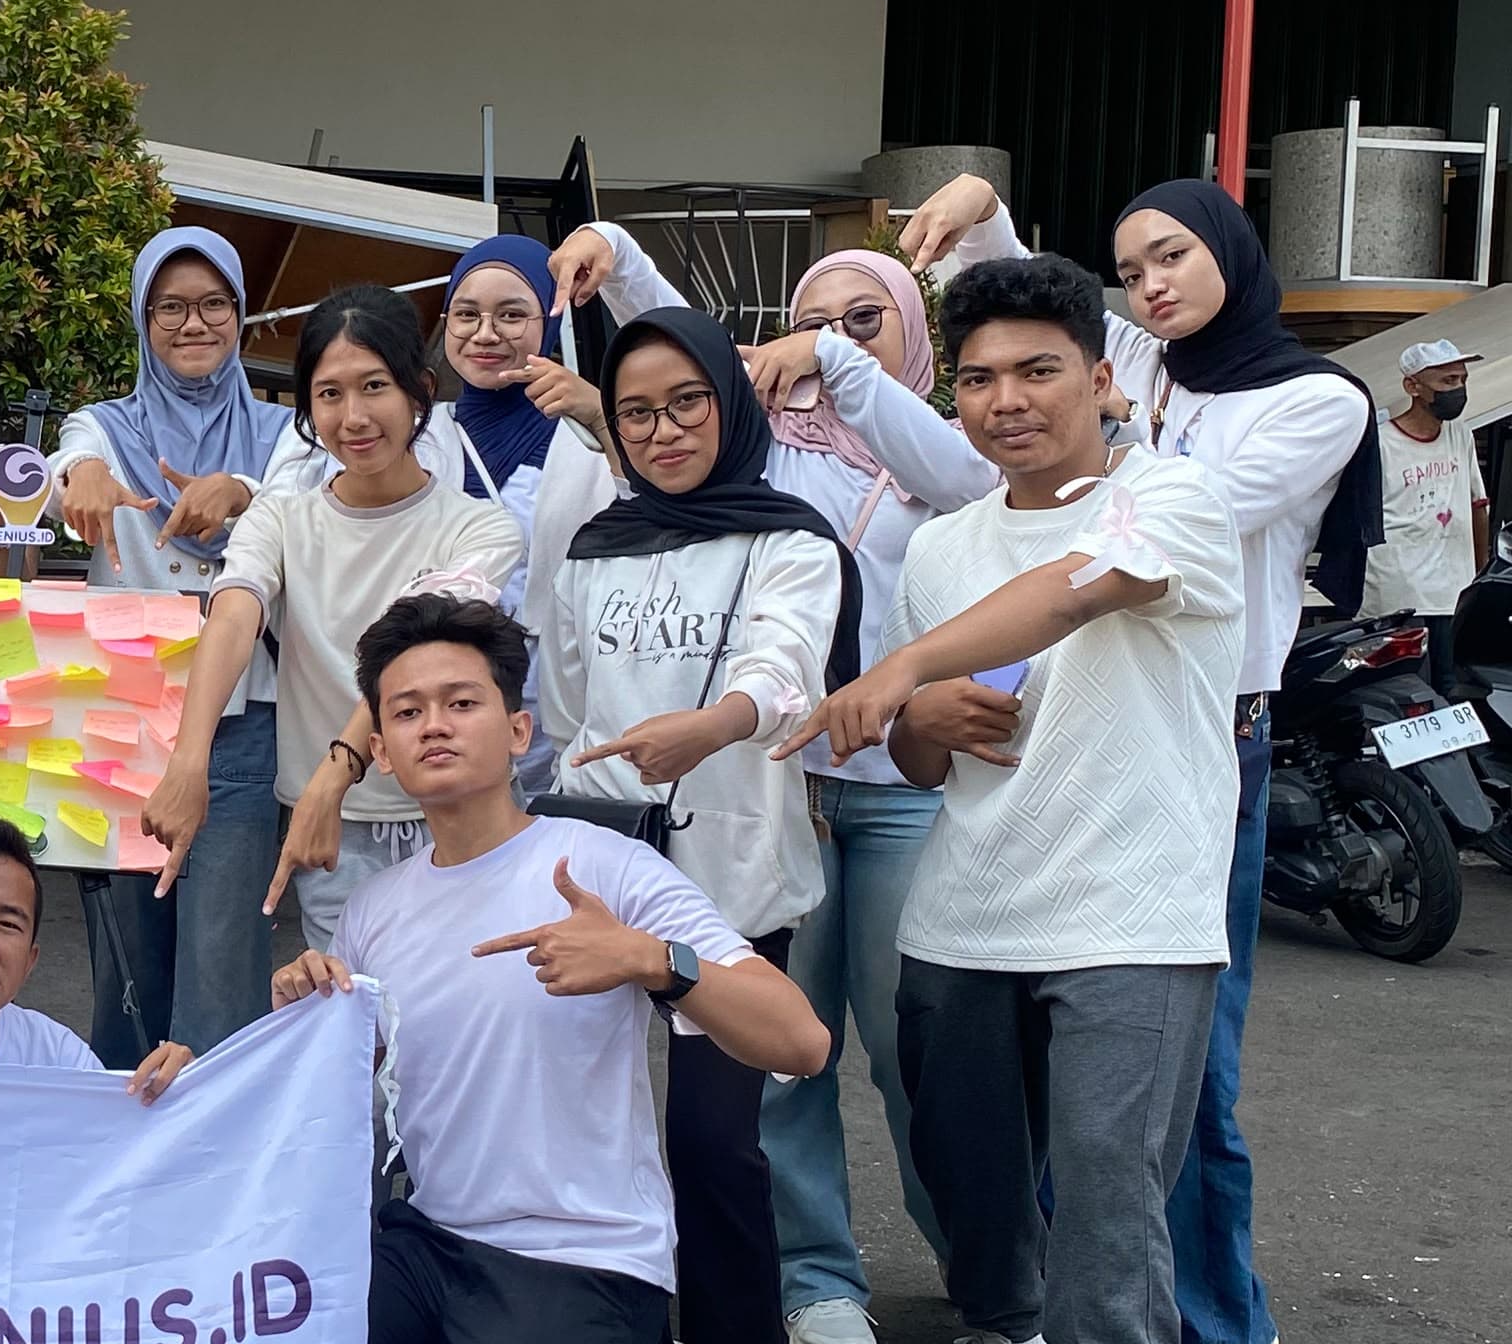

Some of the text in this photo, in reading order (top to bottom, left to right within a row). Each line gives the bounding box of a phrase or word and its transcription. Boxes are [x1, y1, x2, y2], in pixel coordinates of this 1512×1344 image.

[591, 580, 682, 635] fresh
[598, 611, 740, 656] START
[1378, 729, 1392, 747] K
[1400, 716, 1442, 739] 3779
